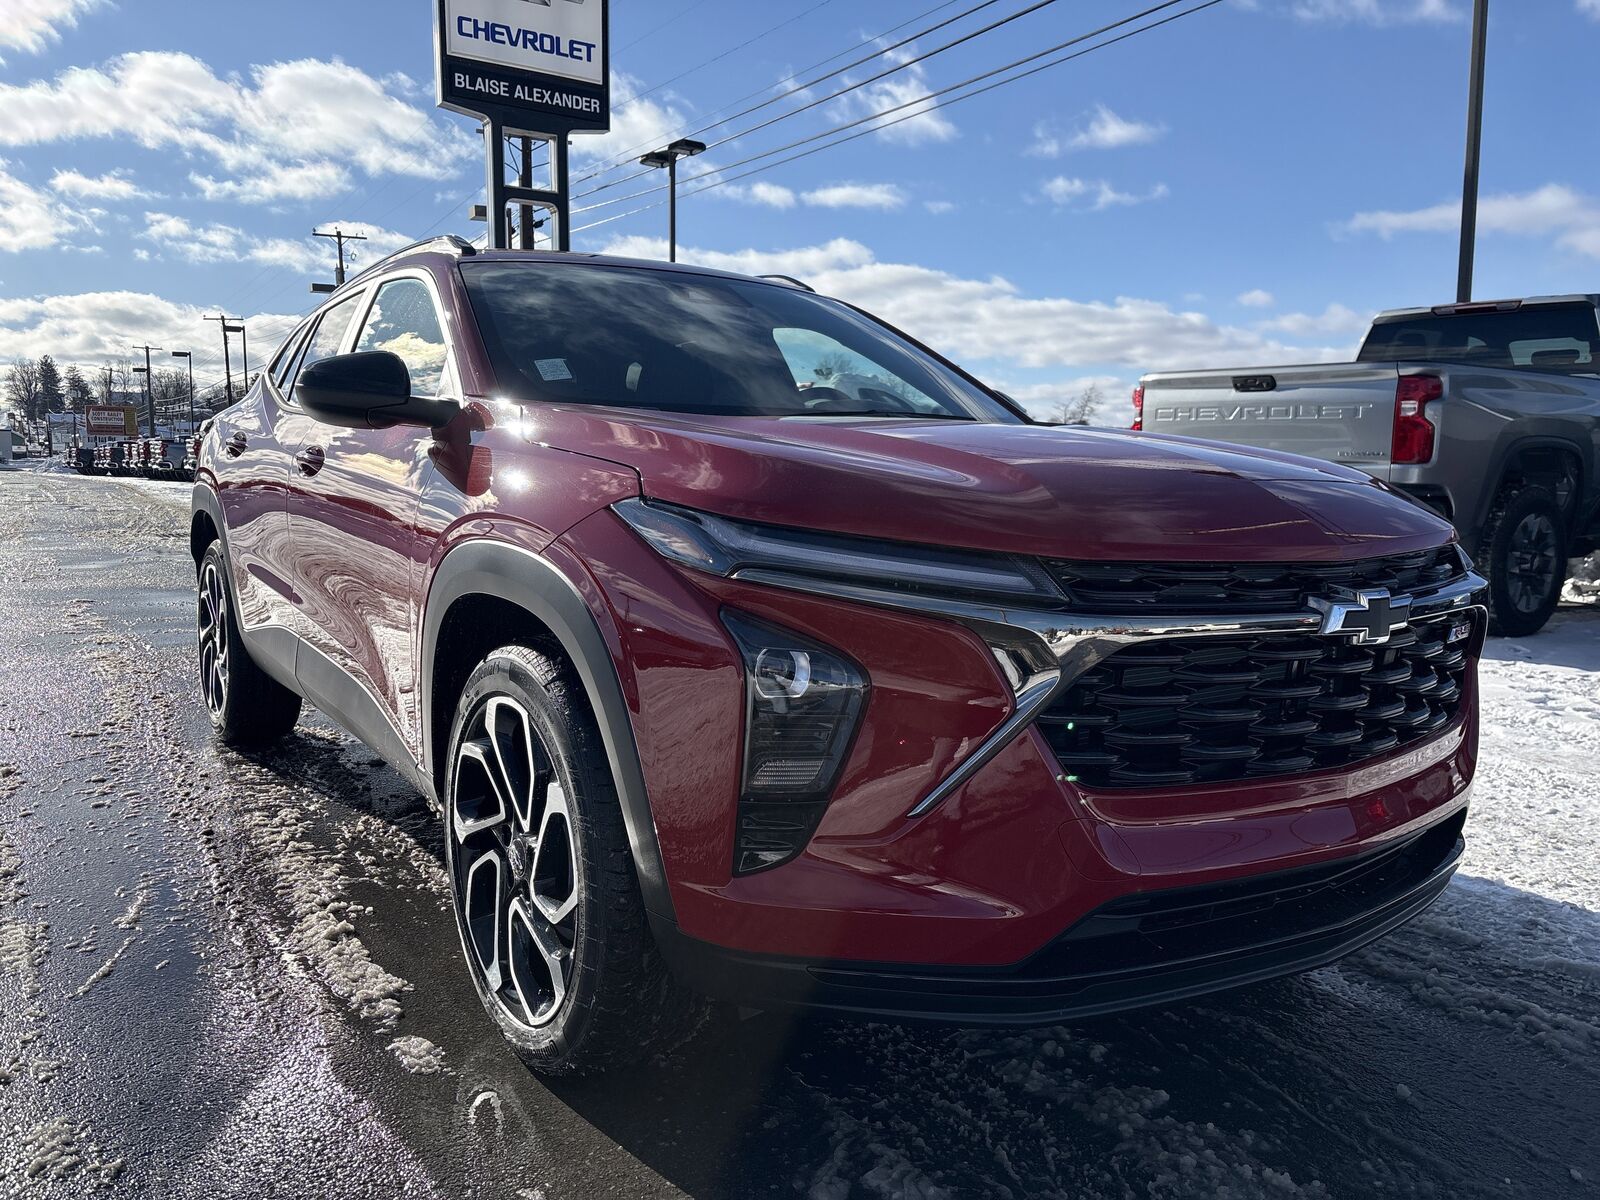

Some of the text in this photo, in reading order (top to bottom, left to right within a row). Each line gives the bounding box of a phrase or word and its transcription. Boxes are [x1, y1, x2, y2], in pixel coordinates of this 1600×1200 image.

[457, 16, 596, 62] CHEVROLET
[454, 72, 600, 113] BLAISE ALEXANDER
[1155, 403, 1373, 422] CHEVROLET
